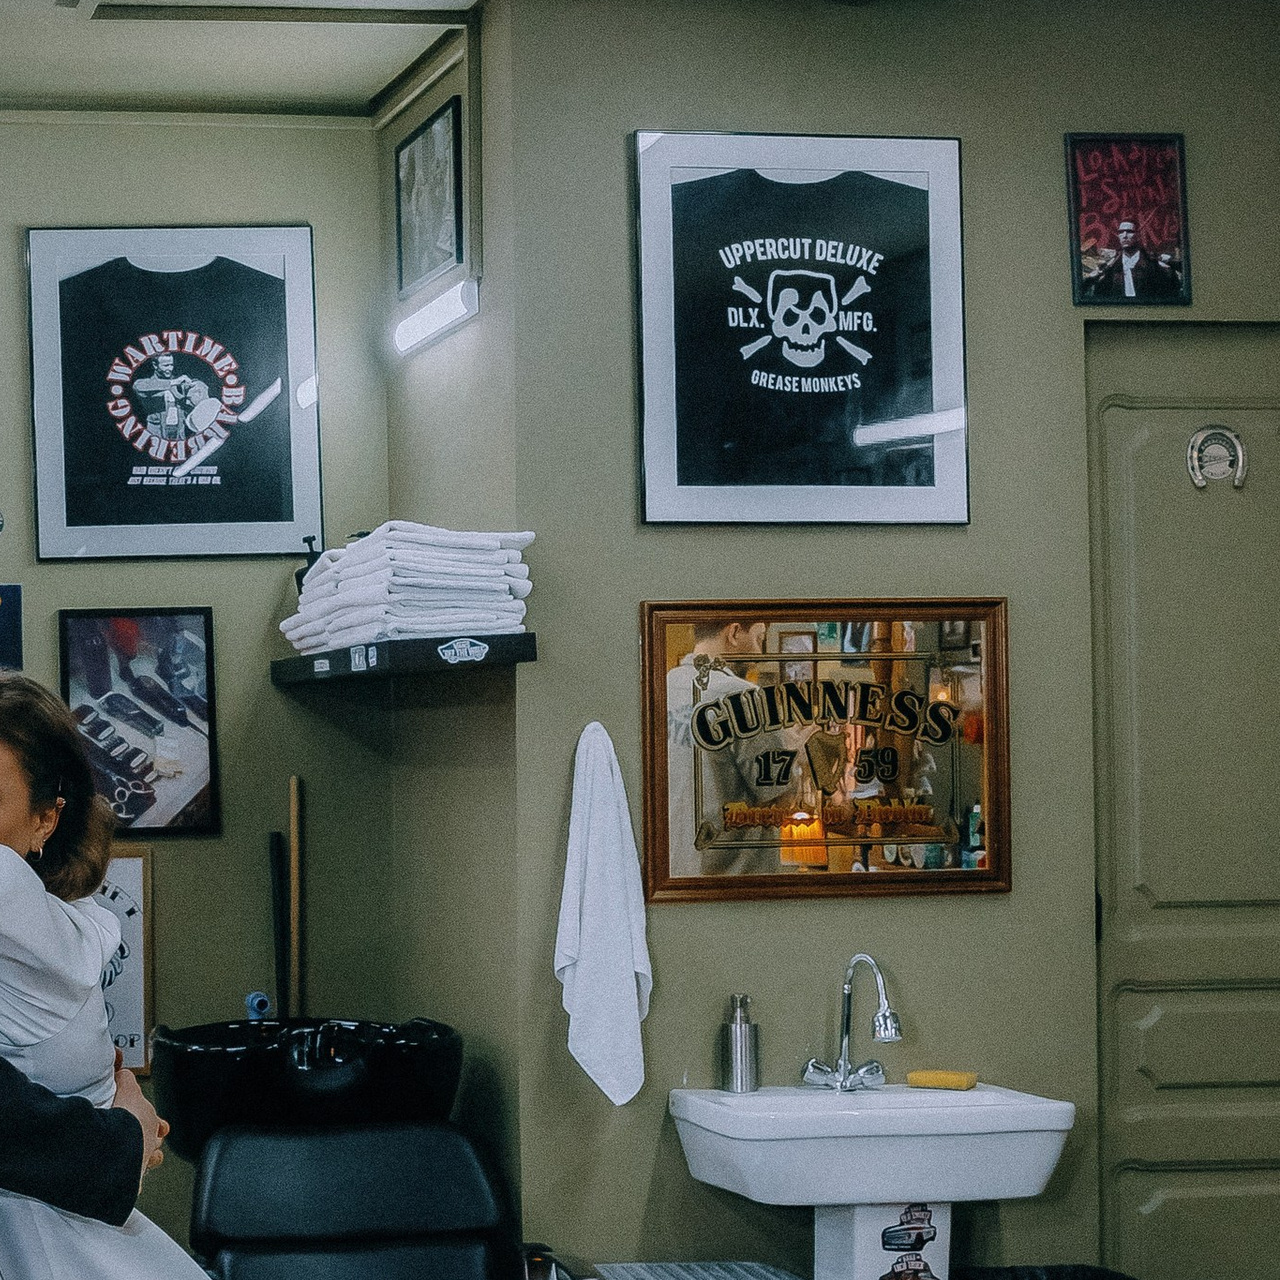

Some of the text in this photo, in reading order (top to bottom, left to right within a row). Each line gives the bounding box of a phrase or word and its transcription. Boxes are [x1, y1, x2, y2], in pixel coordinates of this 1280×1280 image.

[719, 238, 884, 275] UPPERCUT DELUXE
[728, 307, 877, 332] DLX. MFG.
[107, 330, 239, 381] WARTIME
[751, 370, 861, 392] GREASE MONKEYS
[691, 679, 961, 751] GUINNESS
[755, 746, 899, 786] 17 59
